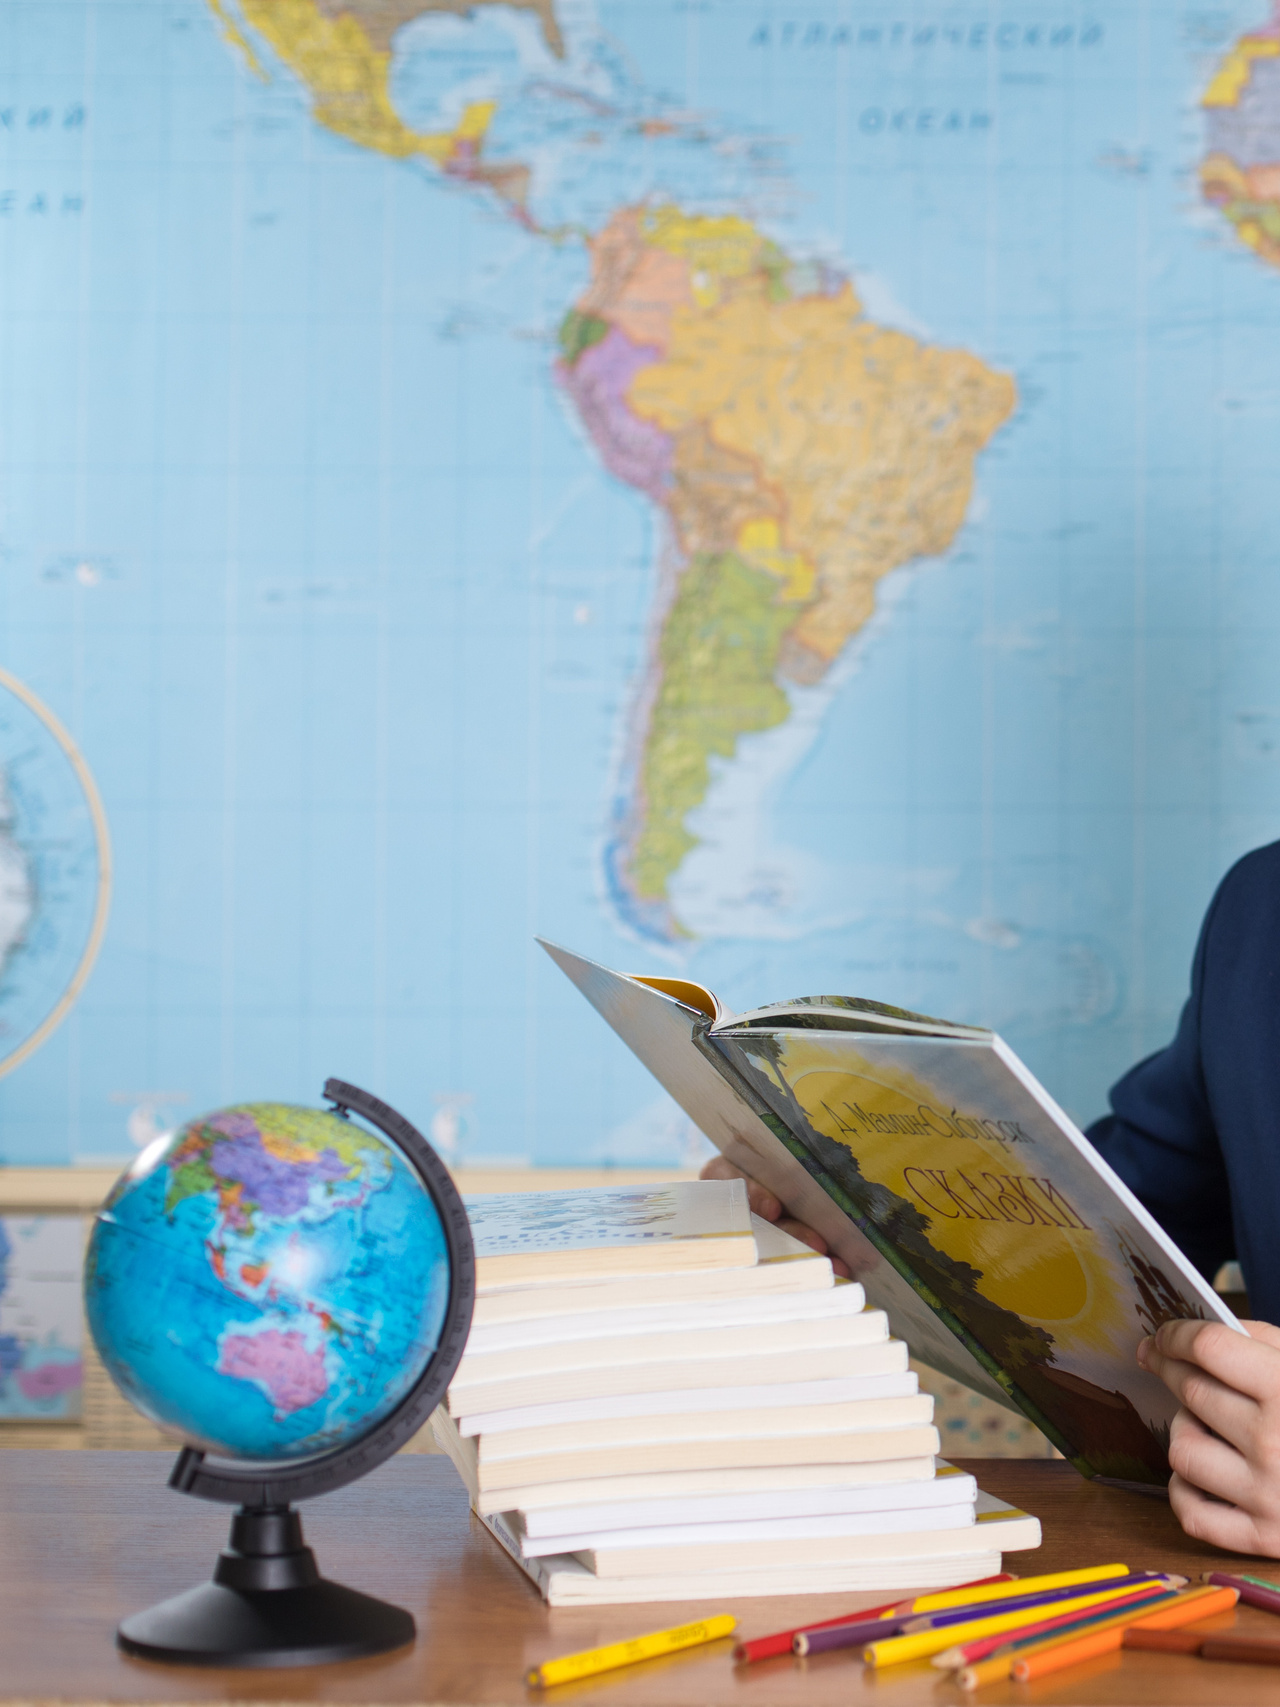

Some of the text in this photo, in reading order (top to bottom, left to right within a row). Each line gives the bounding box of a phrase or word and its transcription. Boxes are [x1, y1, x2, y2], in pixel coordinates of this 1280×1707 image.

[749, 14, 1105, 49] АТЛАНТИЧЕСКИЙ
[857, 105, 993, 136] ОКЕАН
[903, 1166, 1093, 1231] СКАЗКИ
